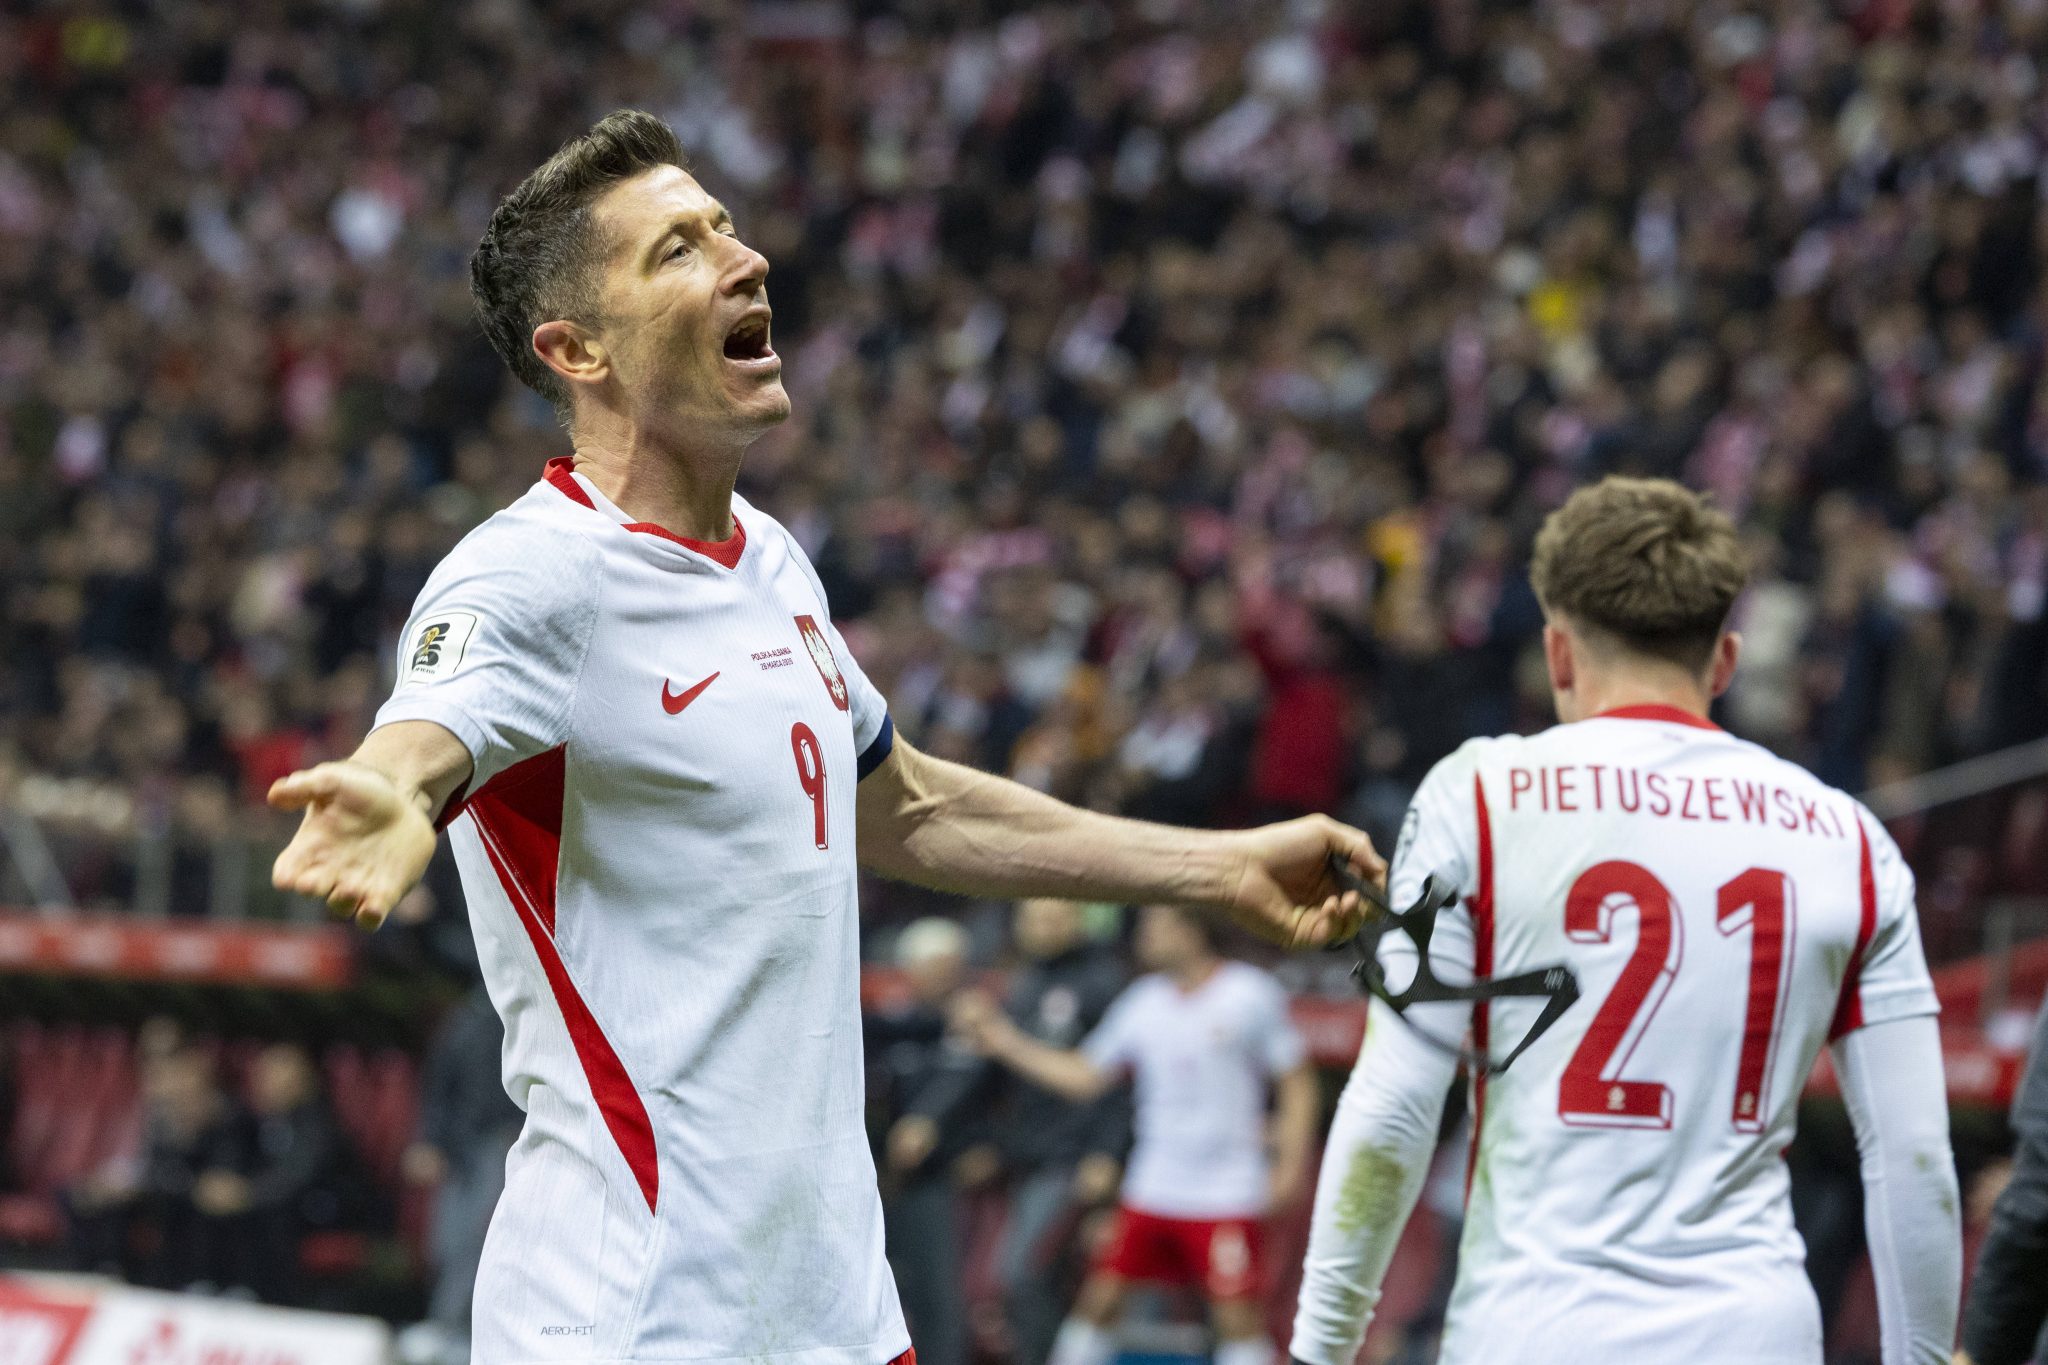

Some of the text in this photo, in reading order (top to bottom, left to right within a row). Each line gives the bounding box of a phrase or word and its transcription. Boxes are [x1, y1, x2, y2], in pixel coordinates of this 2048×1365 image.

[791, 722, 828, 850] 9
[1510, 765, 1845, 838] PIETUSZEWSKI
[1558, 859, 1796, 1134] 21
[540, 1324, 595, 1336] AERO-FIT
